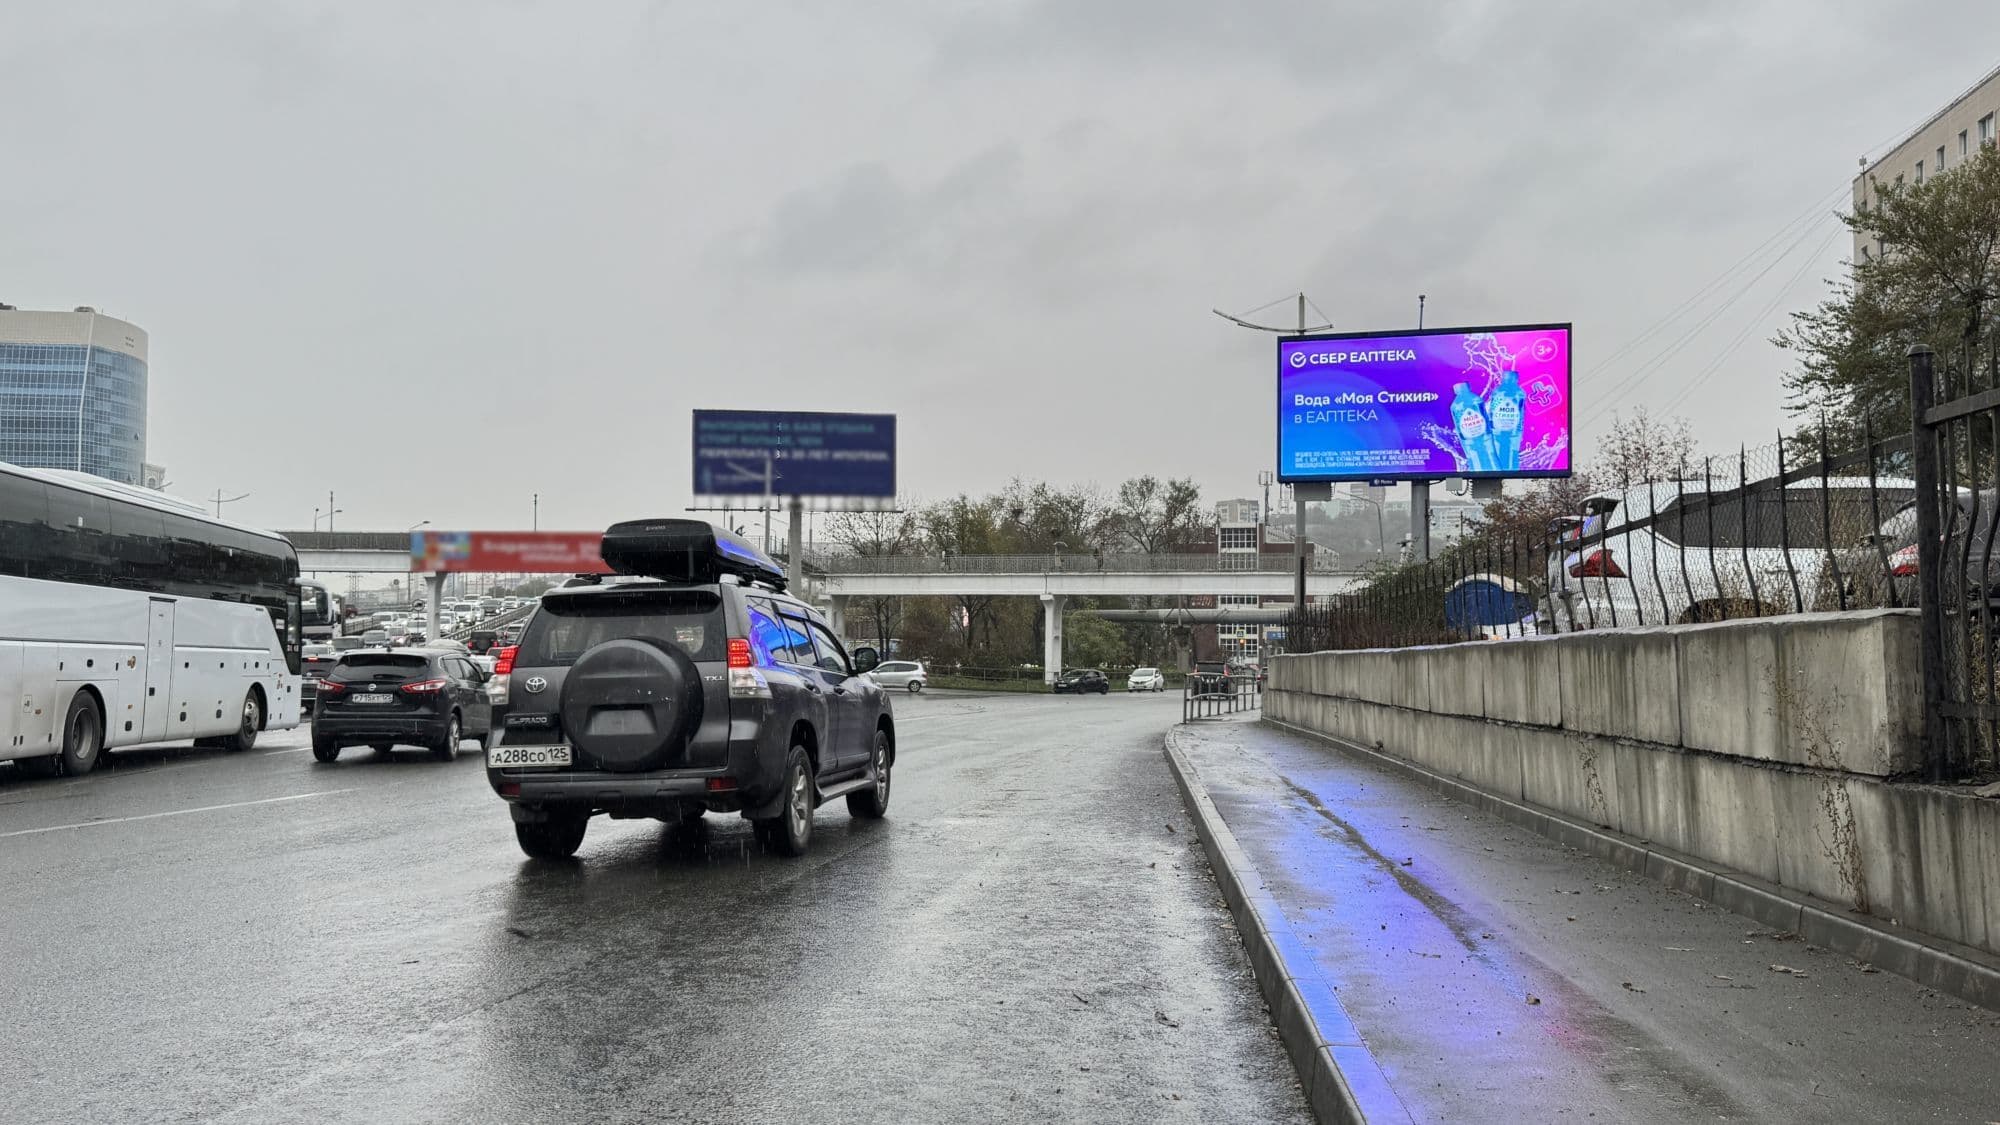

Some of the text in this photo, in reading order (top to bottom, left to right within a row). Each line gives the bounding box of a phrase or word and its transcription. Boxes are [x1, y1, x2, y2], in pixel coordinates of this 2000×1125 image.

[1310, 350, 1416, 364] СБЕР ЕАПТЕКА
[1537, 345, 1553, 355] 3+
[1294, 391, 1439, 407] Вода «Моя Стихия»
[1294, 409, 1378, 424] в ЕАПТЕКА
[547, 747, 566, 761] 125
